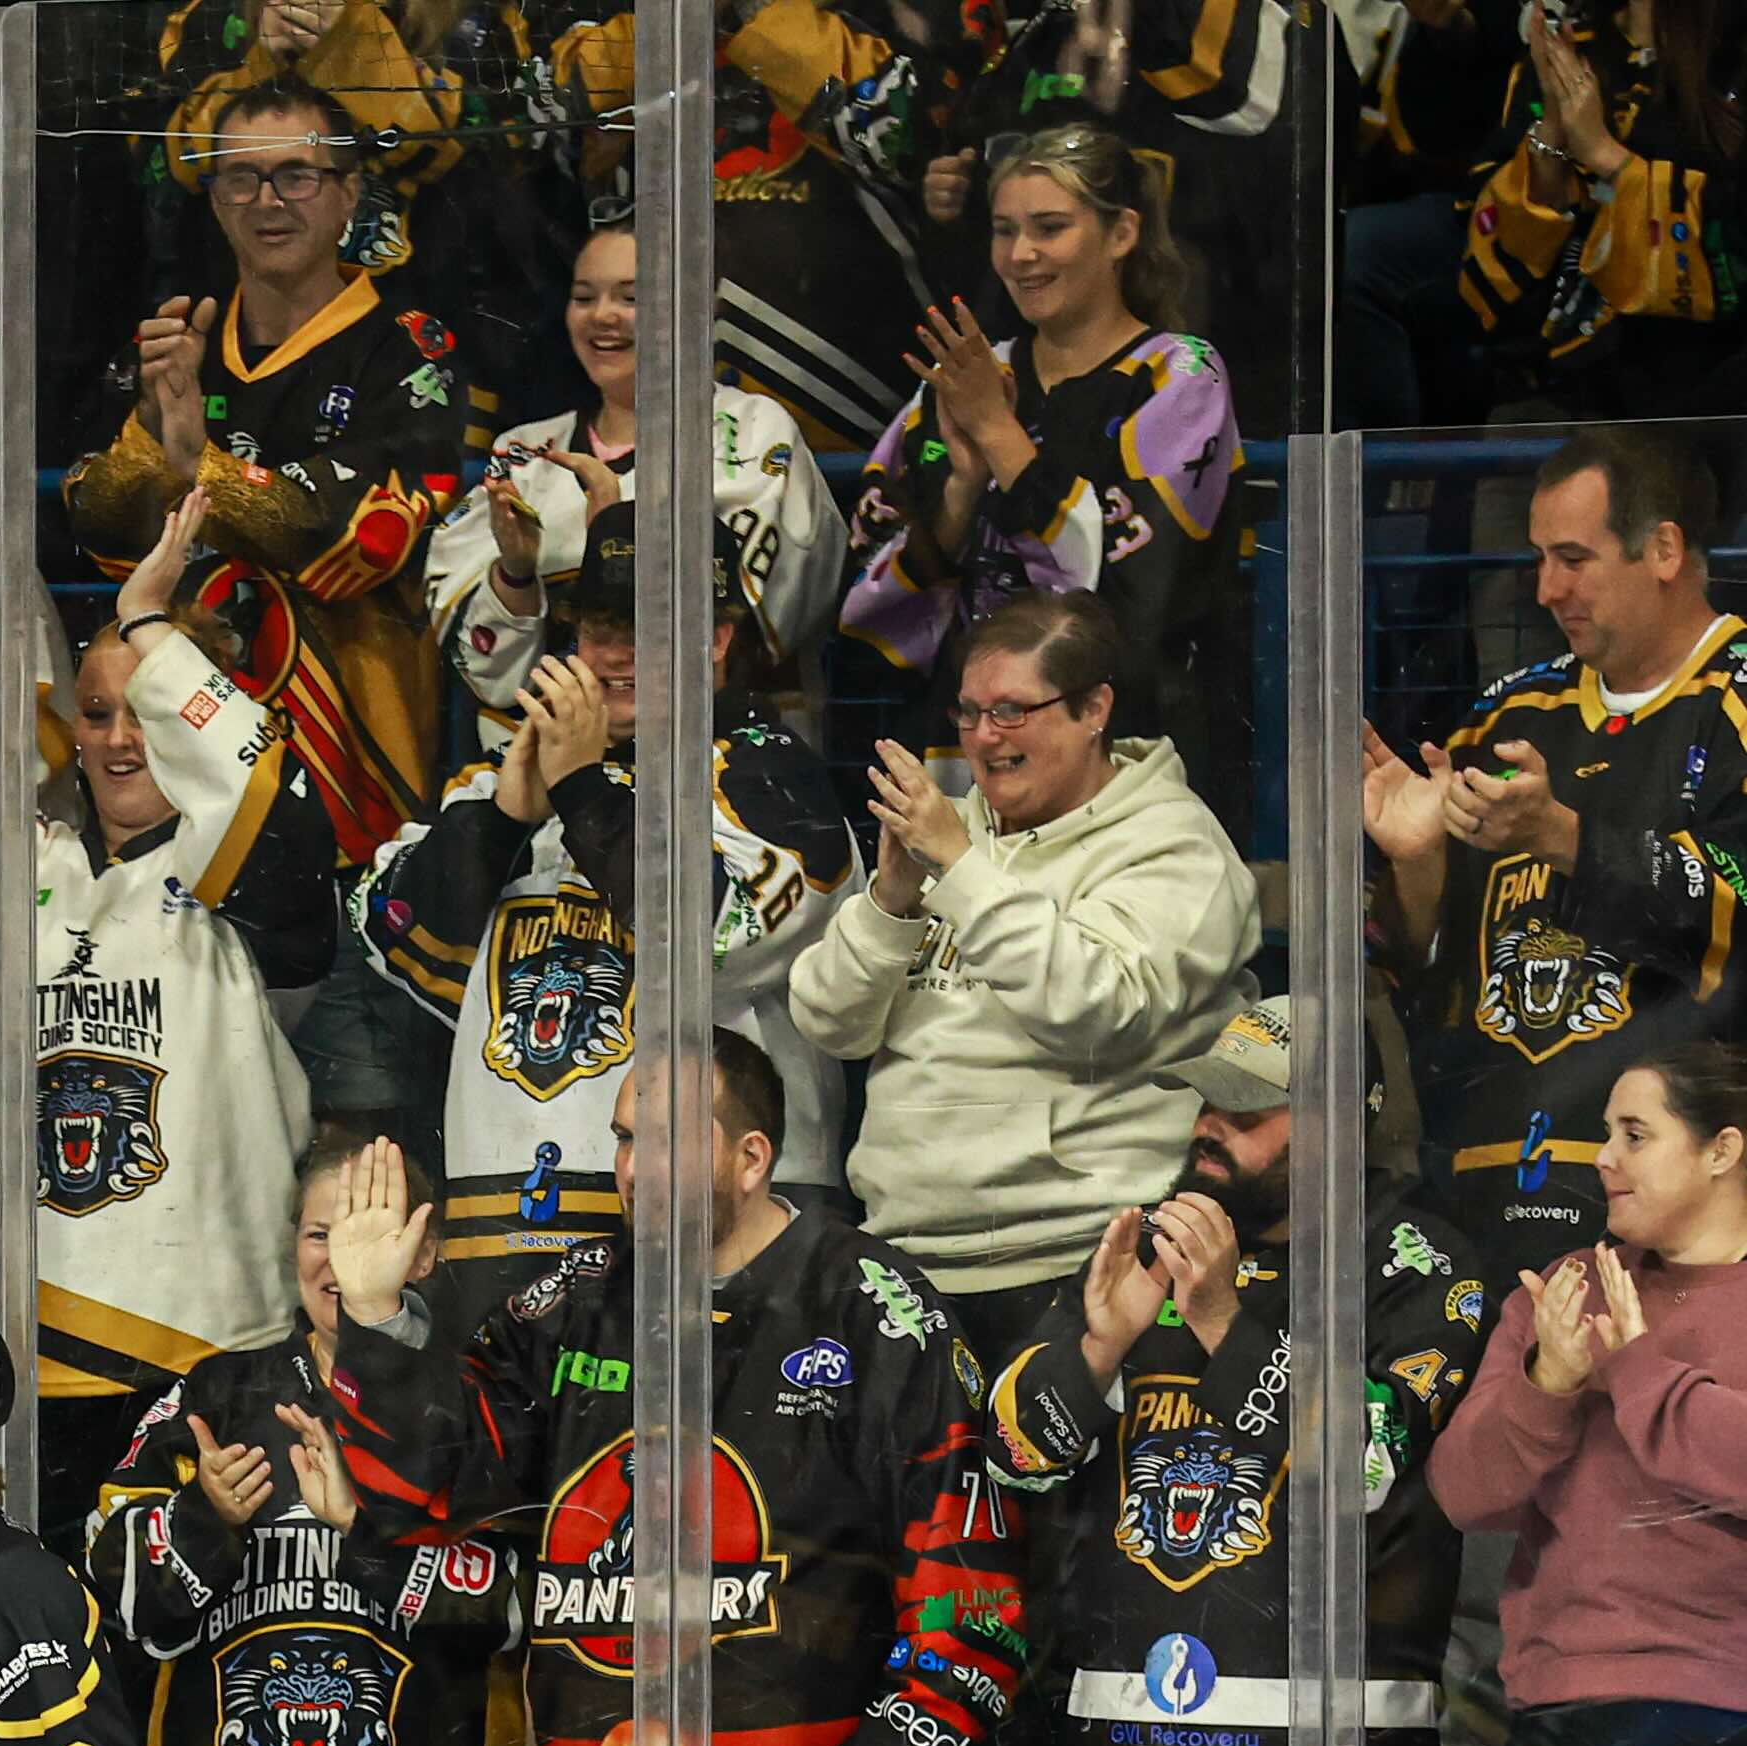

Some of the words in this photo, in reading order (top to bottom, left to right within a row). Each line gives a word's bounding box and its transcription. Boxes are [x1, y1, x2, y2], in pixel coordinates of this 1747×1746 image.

[37, 977, 163, 1034] TTINGHAM
[81, 1021, 163, 1058] SOCIETY
[1515, 1204, 1581, 1226] ecovery
[209, 1579, 318, 1639] BUILDING
[534, 1569, 770, 1627] PANTRS
[1110, 1723, 1143, 1746] GVL
